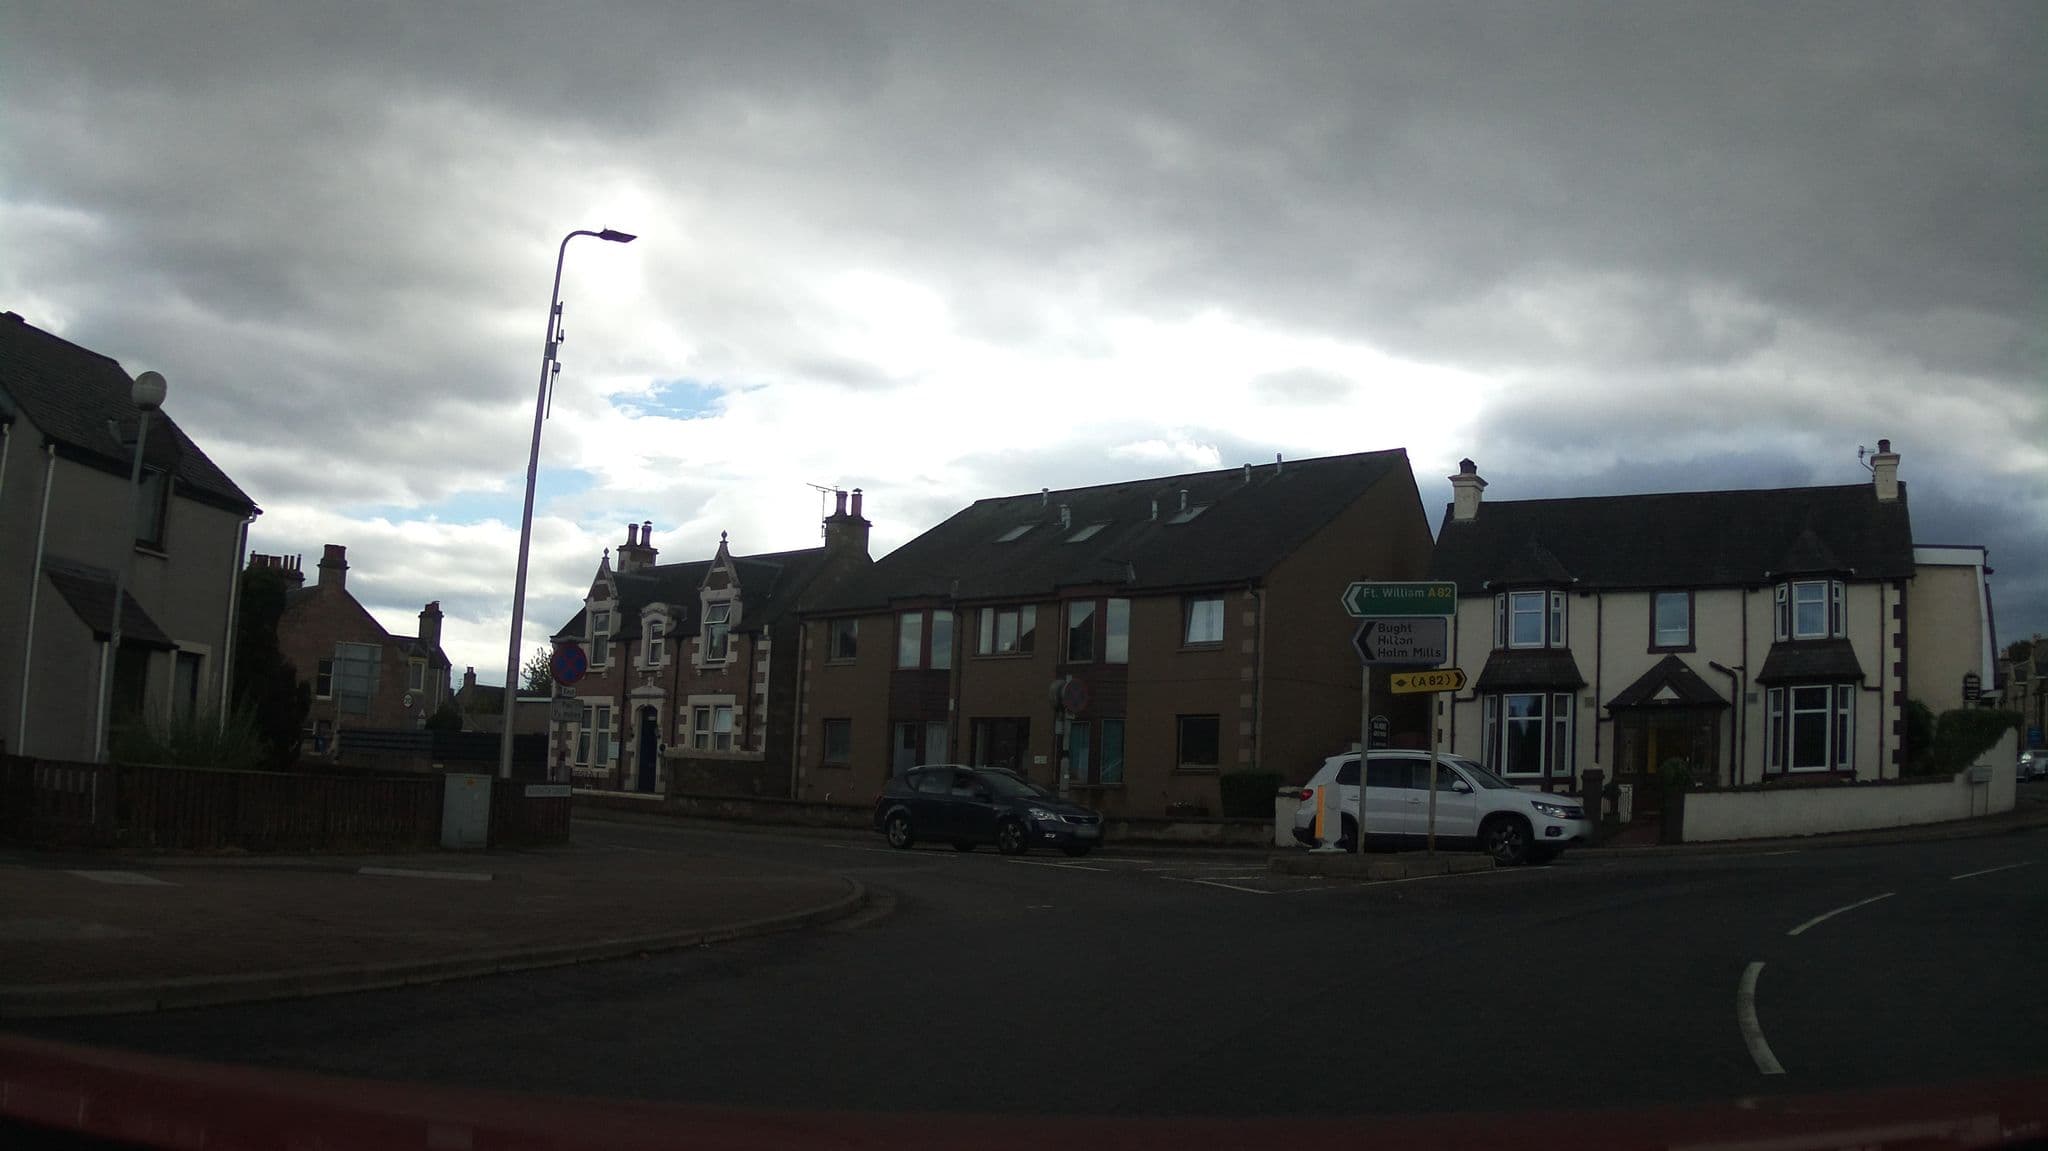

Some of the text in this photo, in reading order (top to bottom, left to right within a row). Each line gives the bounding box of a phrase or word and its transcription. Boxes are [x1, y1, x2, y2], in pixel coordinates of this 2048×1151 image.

[1363, 586, 1452, 599] Ft. William A82
[1378, 623, 1412, 635] Bught
[1378, 635, 1413, 645] Hilton
[1378, 647, 1441, 658] Holm Mills
